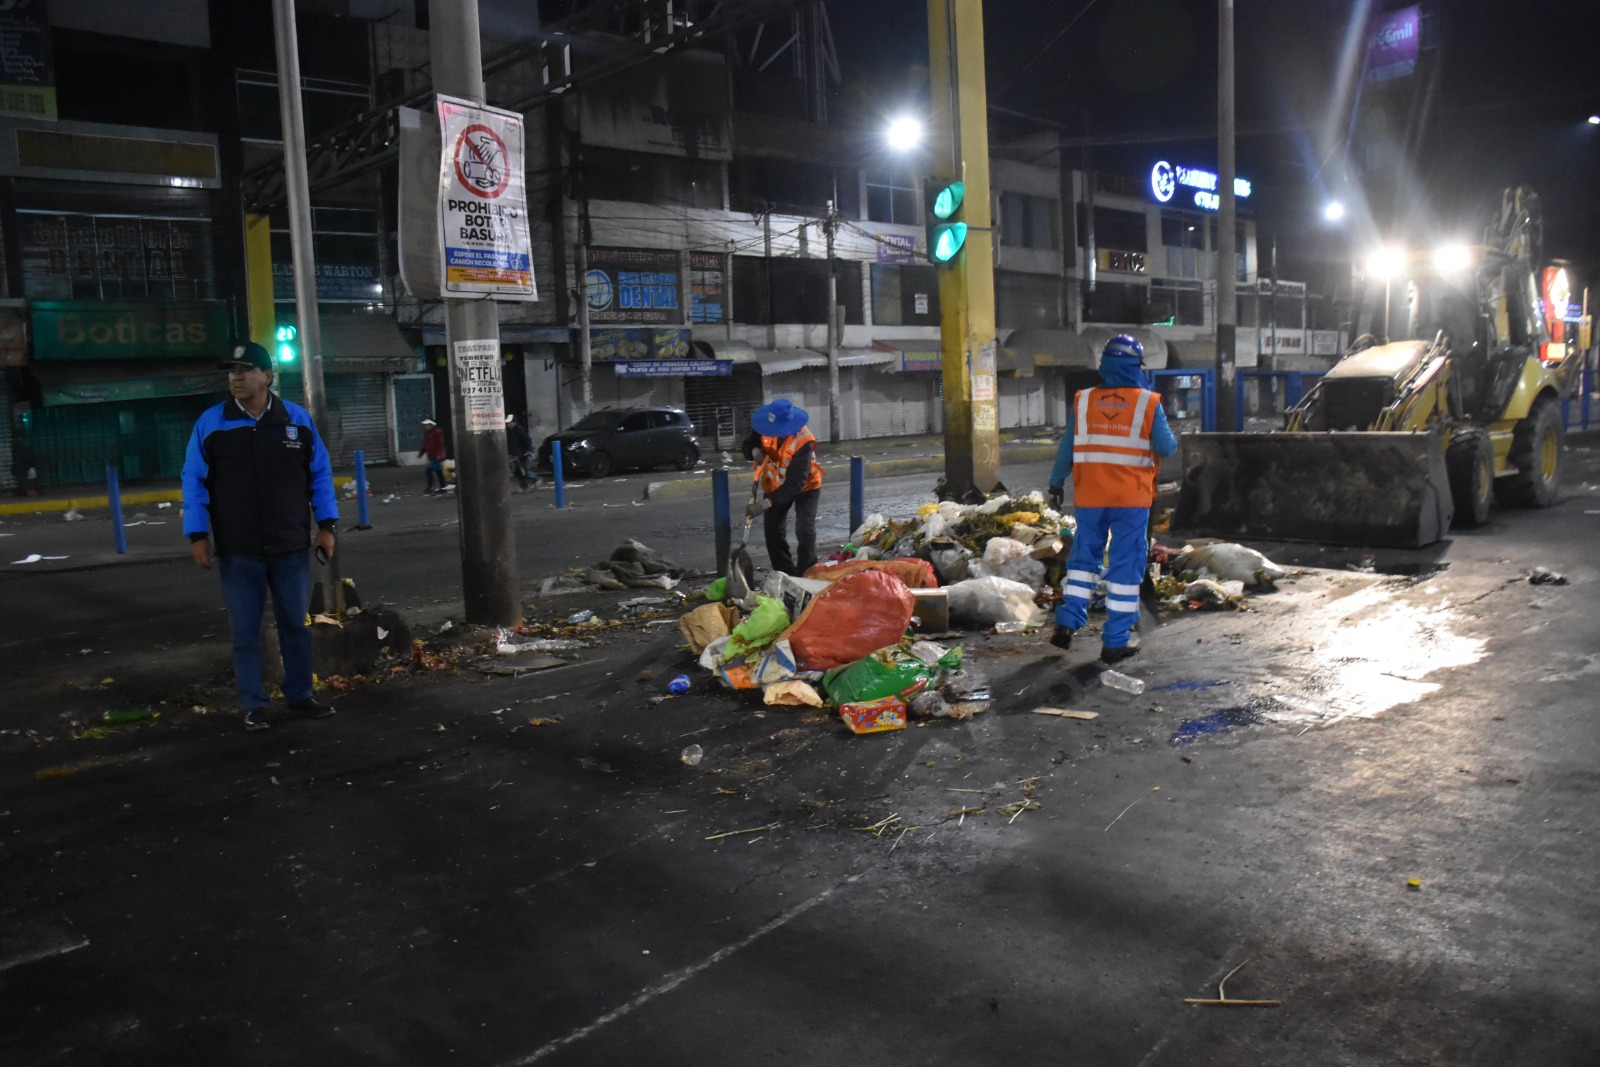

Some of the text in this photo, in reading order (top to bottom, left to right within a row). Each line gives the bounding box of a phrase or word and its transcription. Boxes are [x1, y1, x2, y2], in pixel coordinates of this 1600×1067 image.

[448, 199, 518, 218] PROHIBIDO
[465, 214, 509, 230] BOT
[460, 227, 513, 243] BASU
[880, 235, 911, 247] DENTAL
[48, 248, 188, 280] DENTAL
[474, 259, 509, 268] RECOLECTOR
[619, 285, 679, 309] DENTAL
[57, 315, 208, 345] Boticas
[1265, 336, 1301, 348] EPINAR
